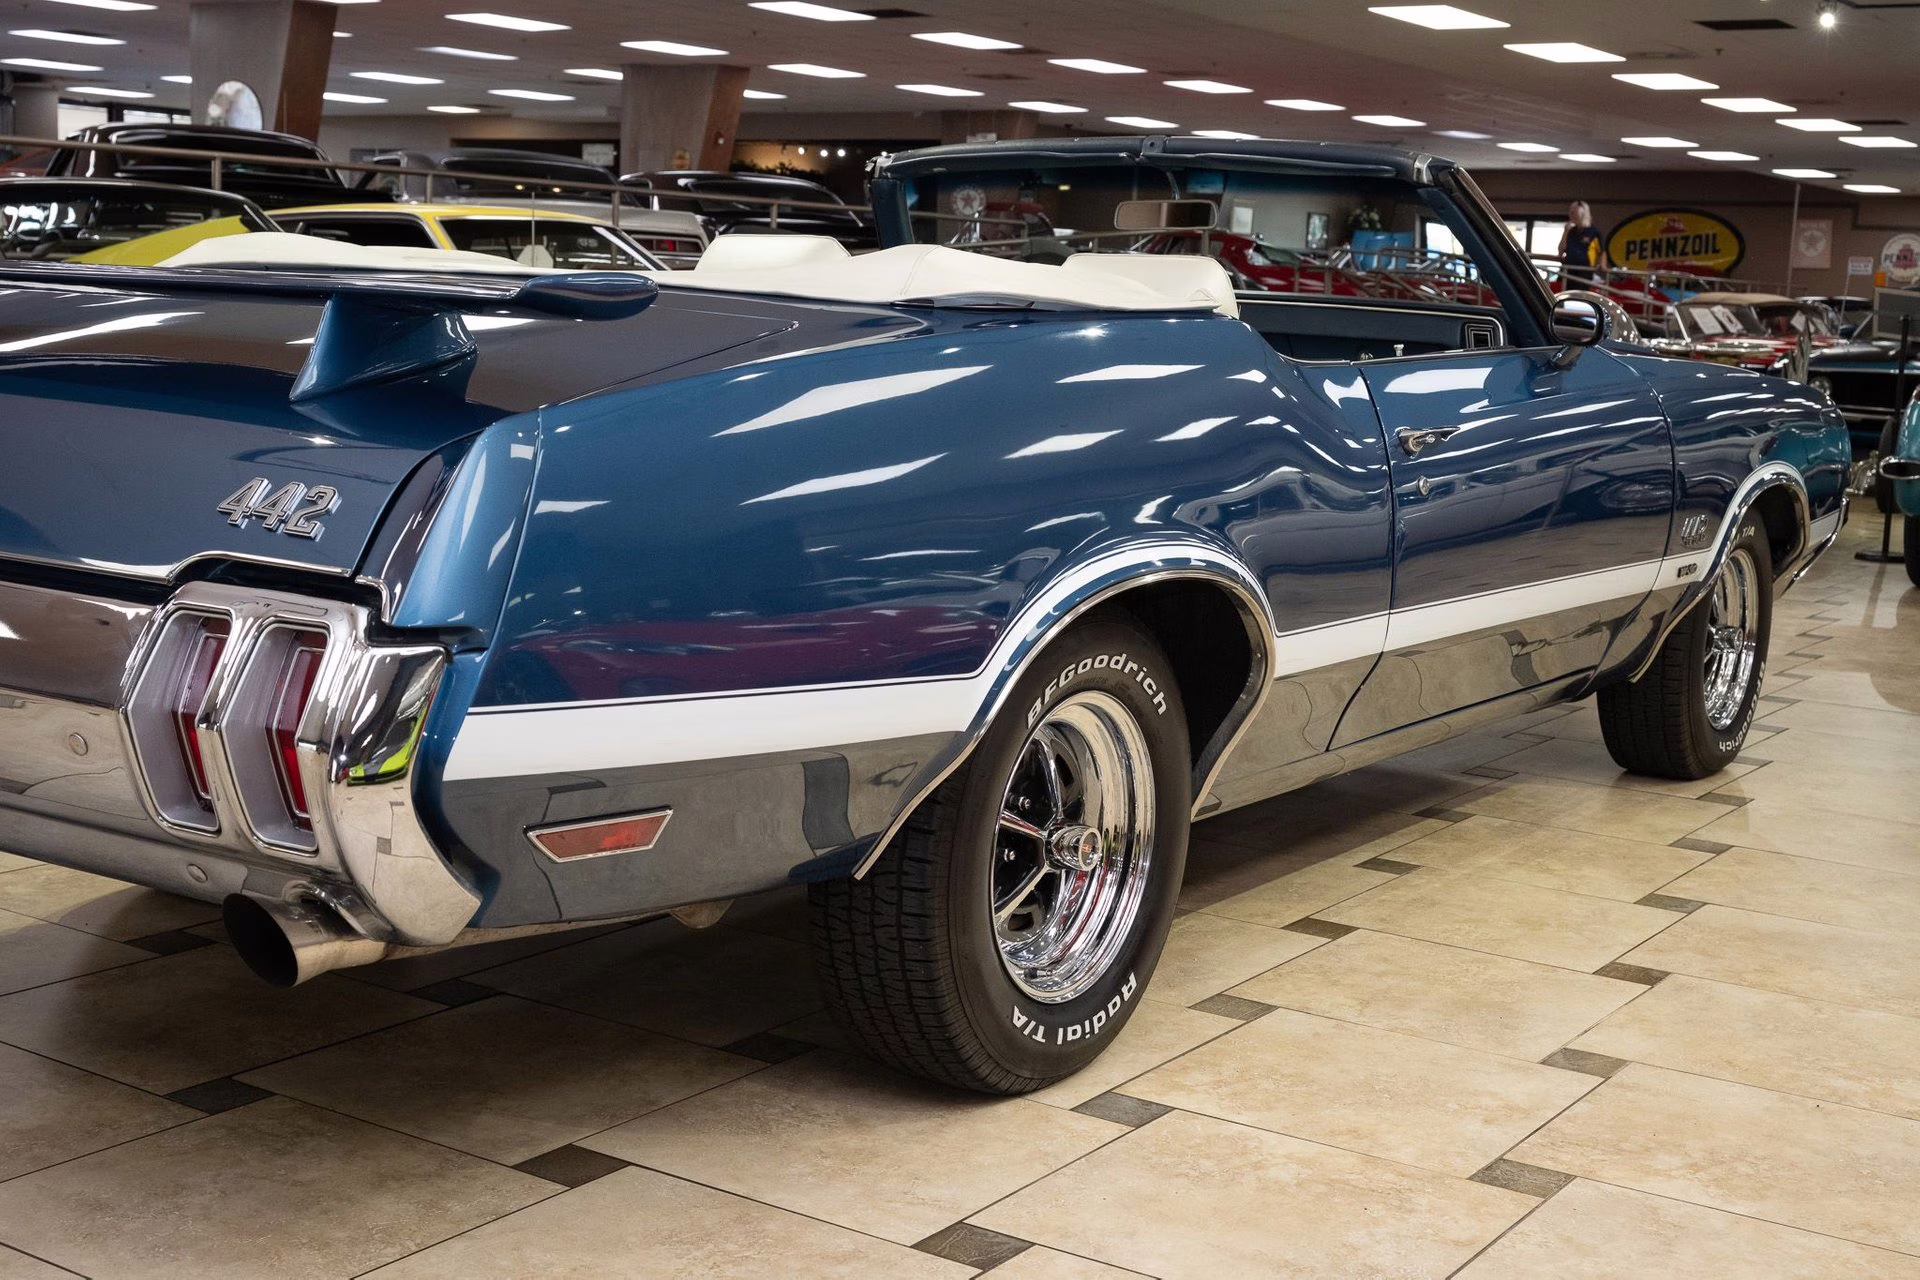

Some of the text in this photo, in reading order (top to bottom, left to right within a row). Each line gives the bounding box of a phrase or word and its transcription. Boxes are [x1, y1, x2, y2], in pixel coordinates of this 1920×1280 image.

[1625, 232, 1721, 261] PENNZOIL
[217, 477, 340, 540] 442
[1027, 653, 1168, 729] BFGoodrich
[1012, 971, 1138, 1045] Radial T/A
